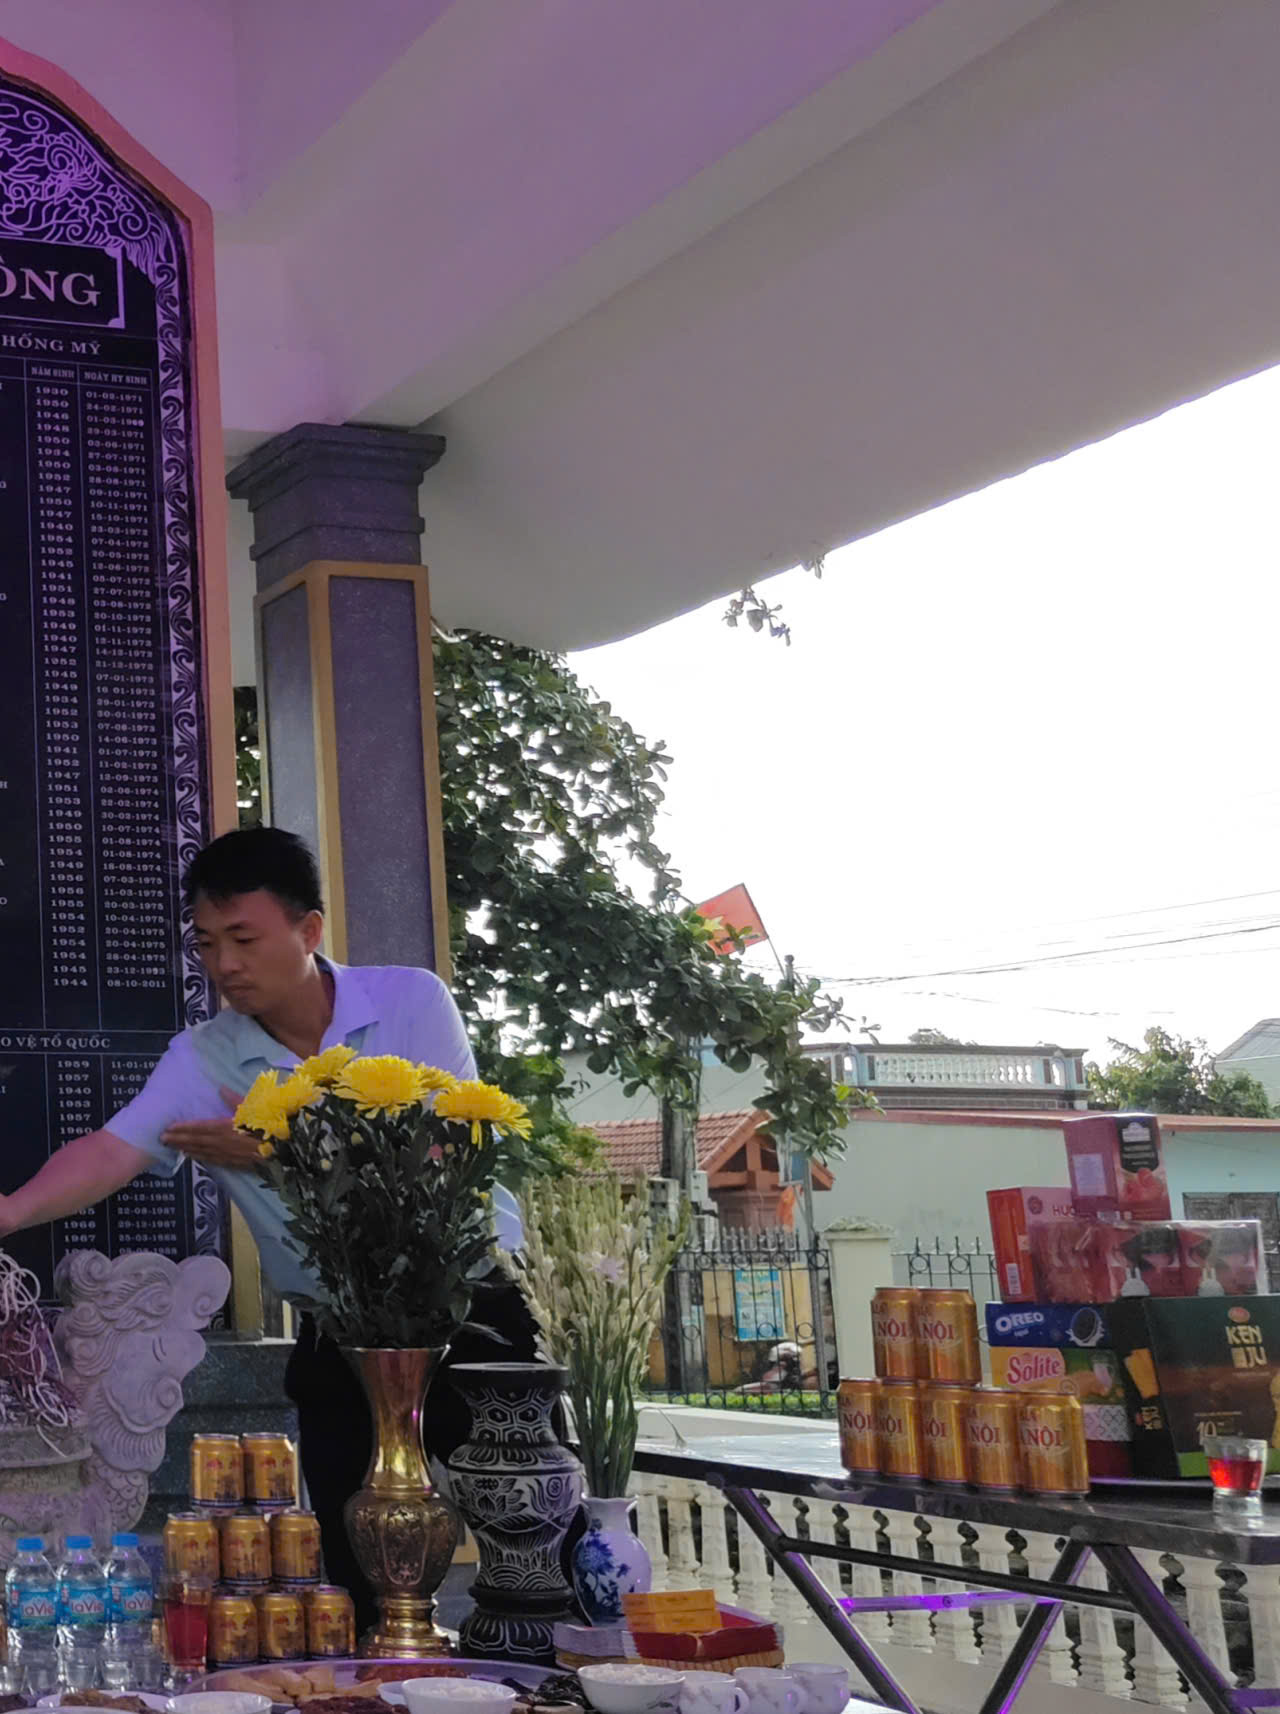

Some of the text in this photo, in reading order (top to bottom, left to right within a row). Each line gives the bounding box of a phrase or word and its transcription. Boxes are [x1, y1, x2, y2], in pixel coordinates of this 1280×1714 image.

[71, 339, 101, 355] MỸ
[15, 1034, 37, 1049] VỆ
[40, 1032, 62, 1047] TỔ
[65, 1034, 111, 1049] QUỐC
[995, 1311, 1045, 1333] OREO
[1225, 1324, 1263, 1346] KEN
[1006, 1353, 1062, 1386] Solite
